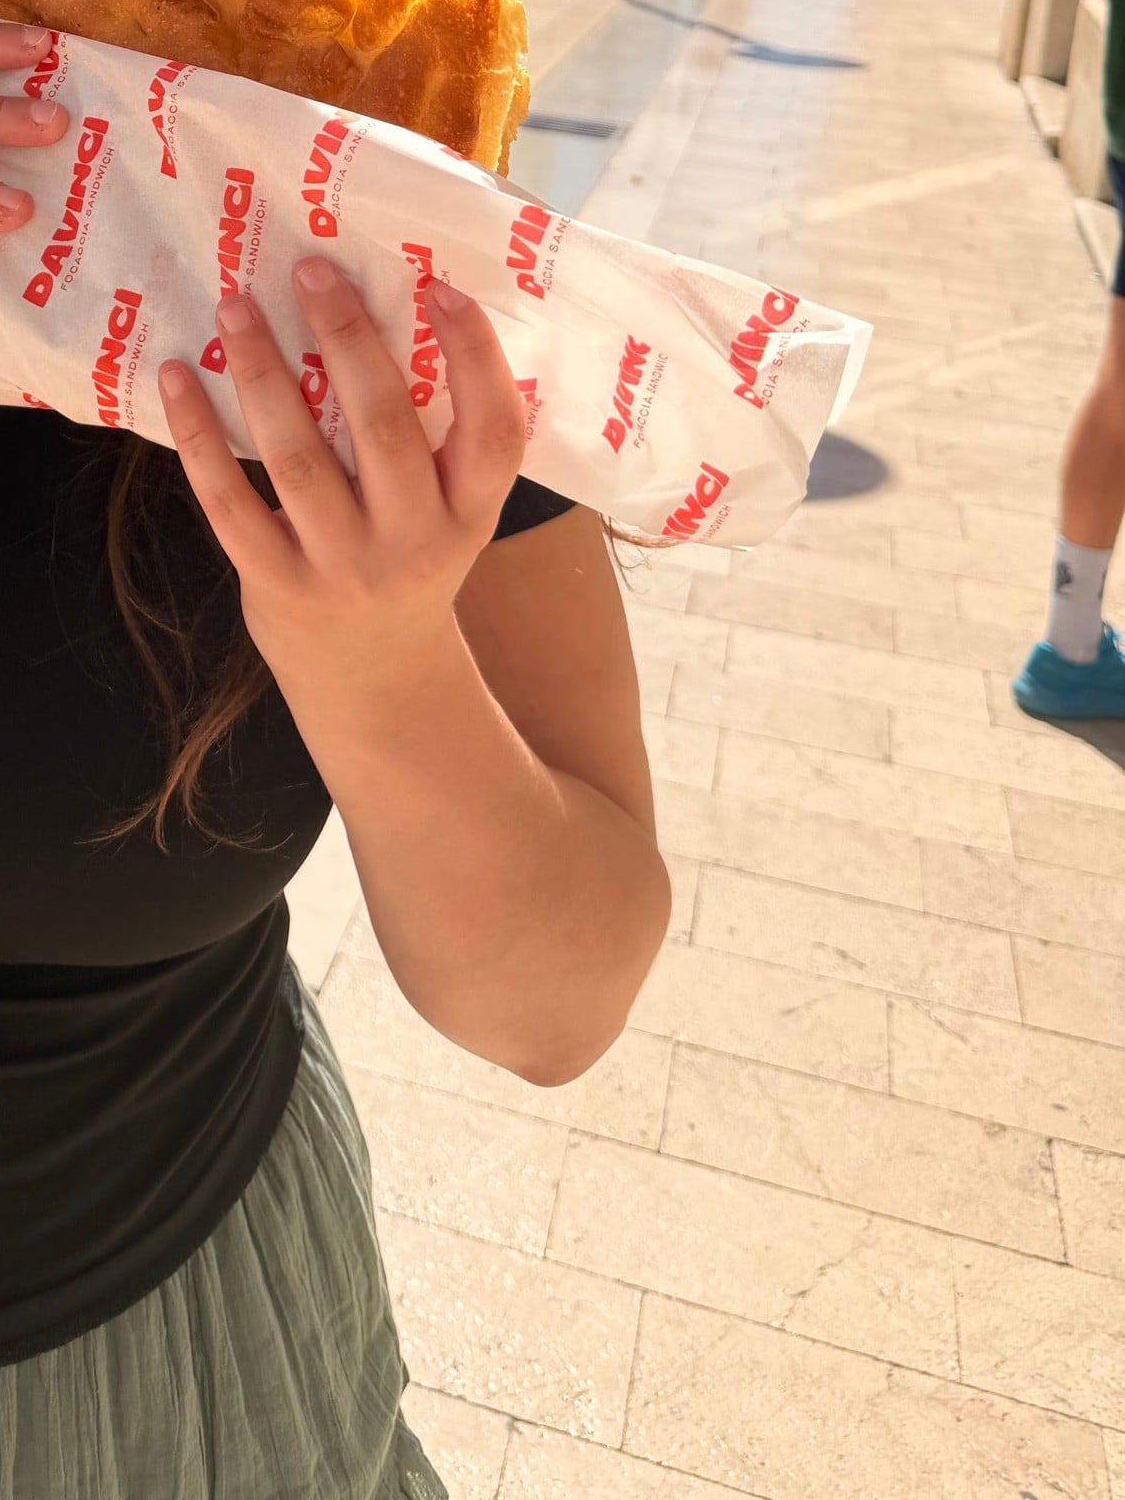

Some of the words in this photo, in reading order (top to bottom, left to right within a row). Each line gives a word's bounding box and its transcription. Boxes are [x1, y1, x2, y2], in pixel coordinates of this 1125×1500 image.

[22, 116, 110, 309] DAVINCI
[60, 222, 90, 292] FOCACCIA
[85, 147, 115, 218] SANDWICH
[199, 167, 255, 375] DVINCI
[246, 199, 268, 277] SANDWICH
[125, 323, 150, 396] SANDWICH
